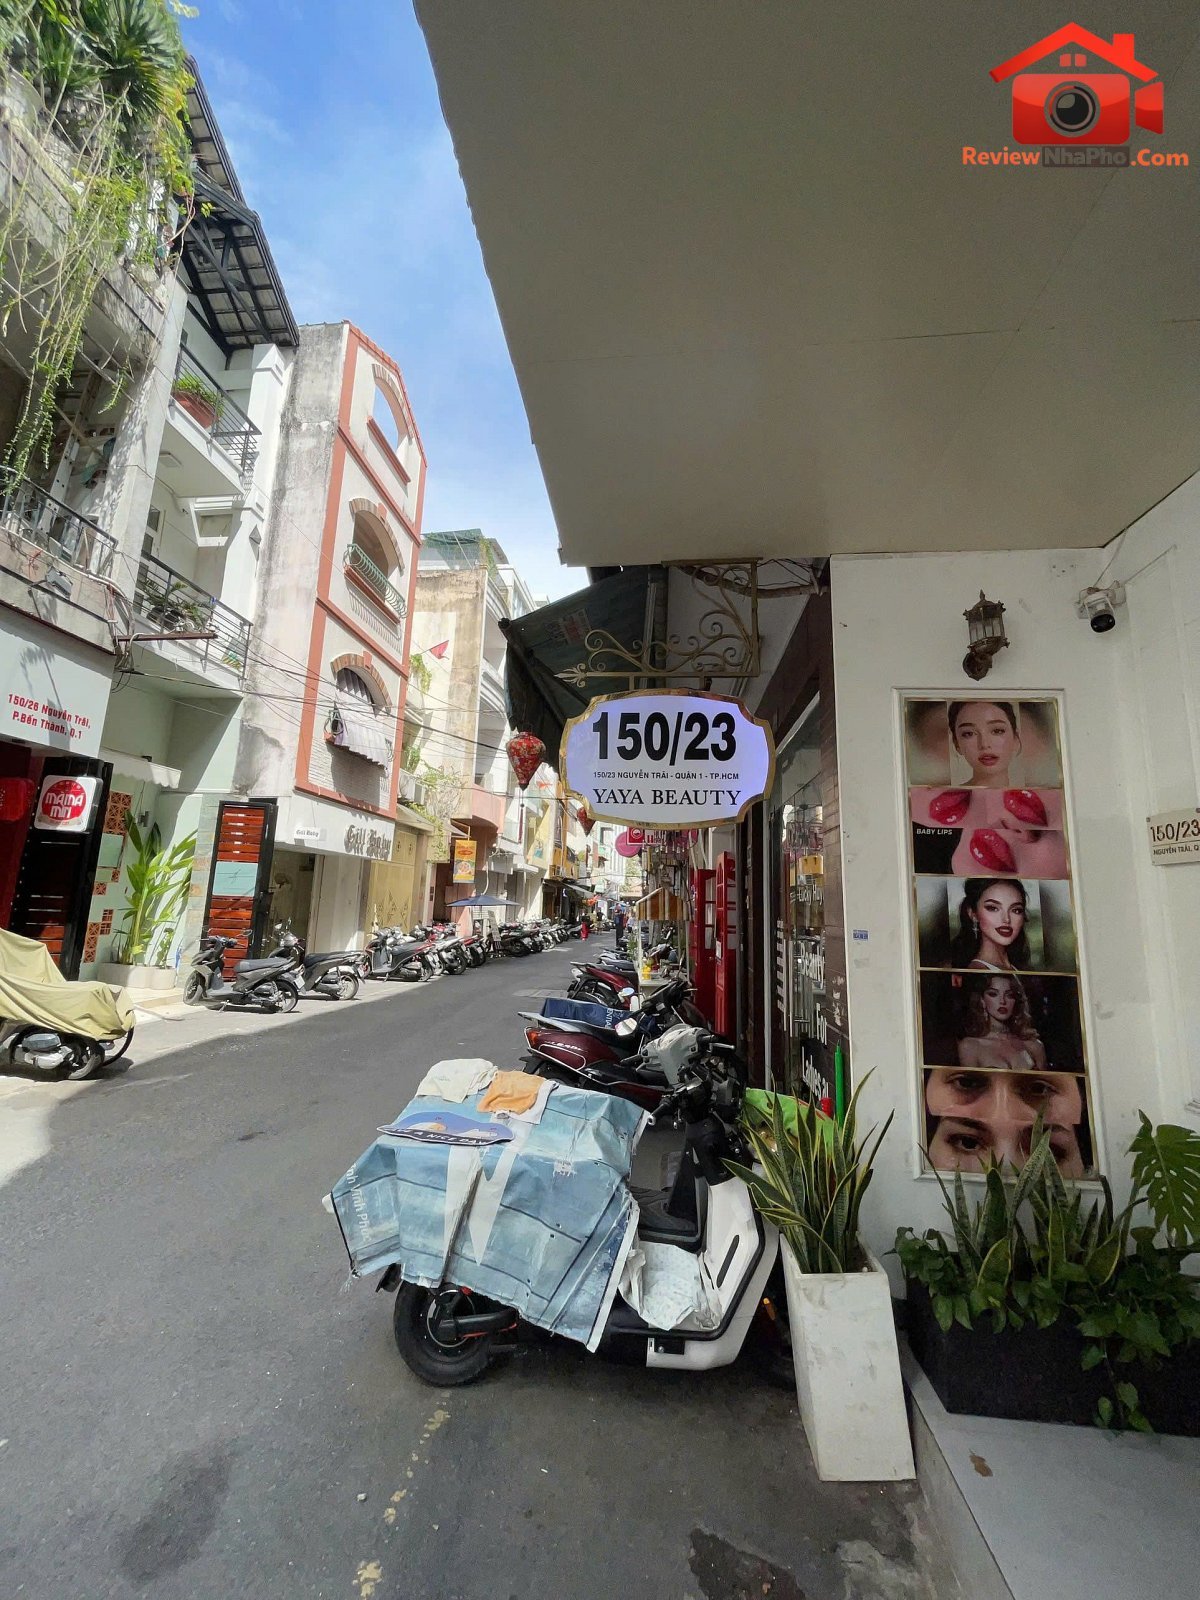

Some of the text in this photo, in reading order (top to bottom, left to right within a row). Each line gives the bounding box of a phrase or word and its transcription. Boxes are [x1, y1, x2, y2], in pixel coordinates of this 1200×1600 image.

[69, 728, 82, 740] Q.1
[592, 711, 737, 766] 150/23
[593, 771, 616, 779] 150/23
[617, 769, 649, 779] NGUYỄN
[652, 770, 669, 779] TRÃI
[675, 770, 697, 780] QUẬN
[710, 772, 739, 780] TP.HCM
[593, 788, 742, 806] YAYA BEAUTY
[1150, 818, 1200, 842] 150/23
[816, 1002, 828, 1046] For
